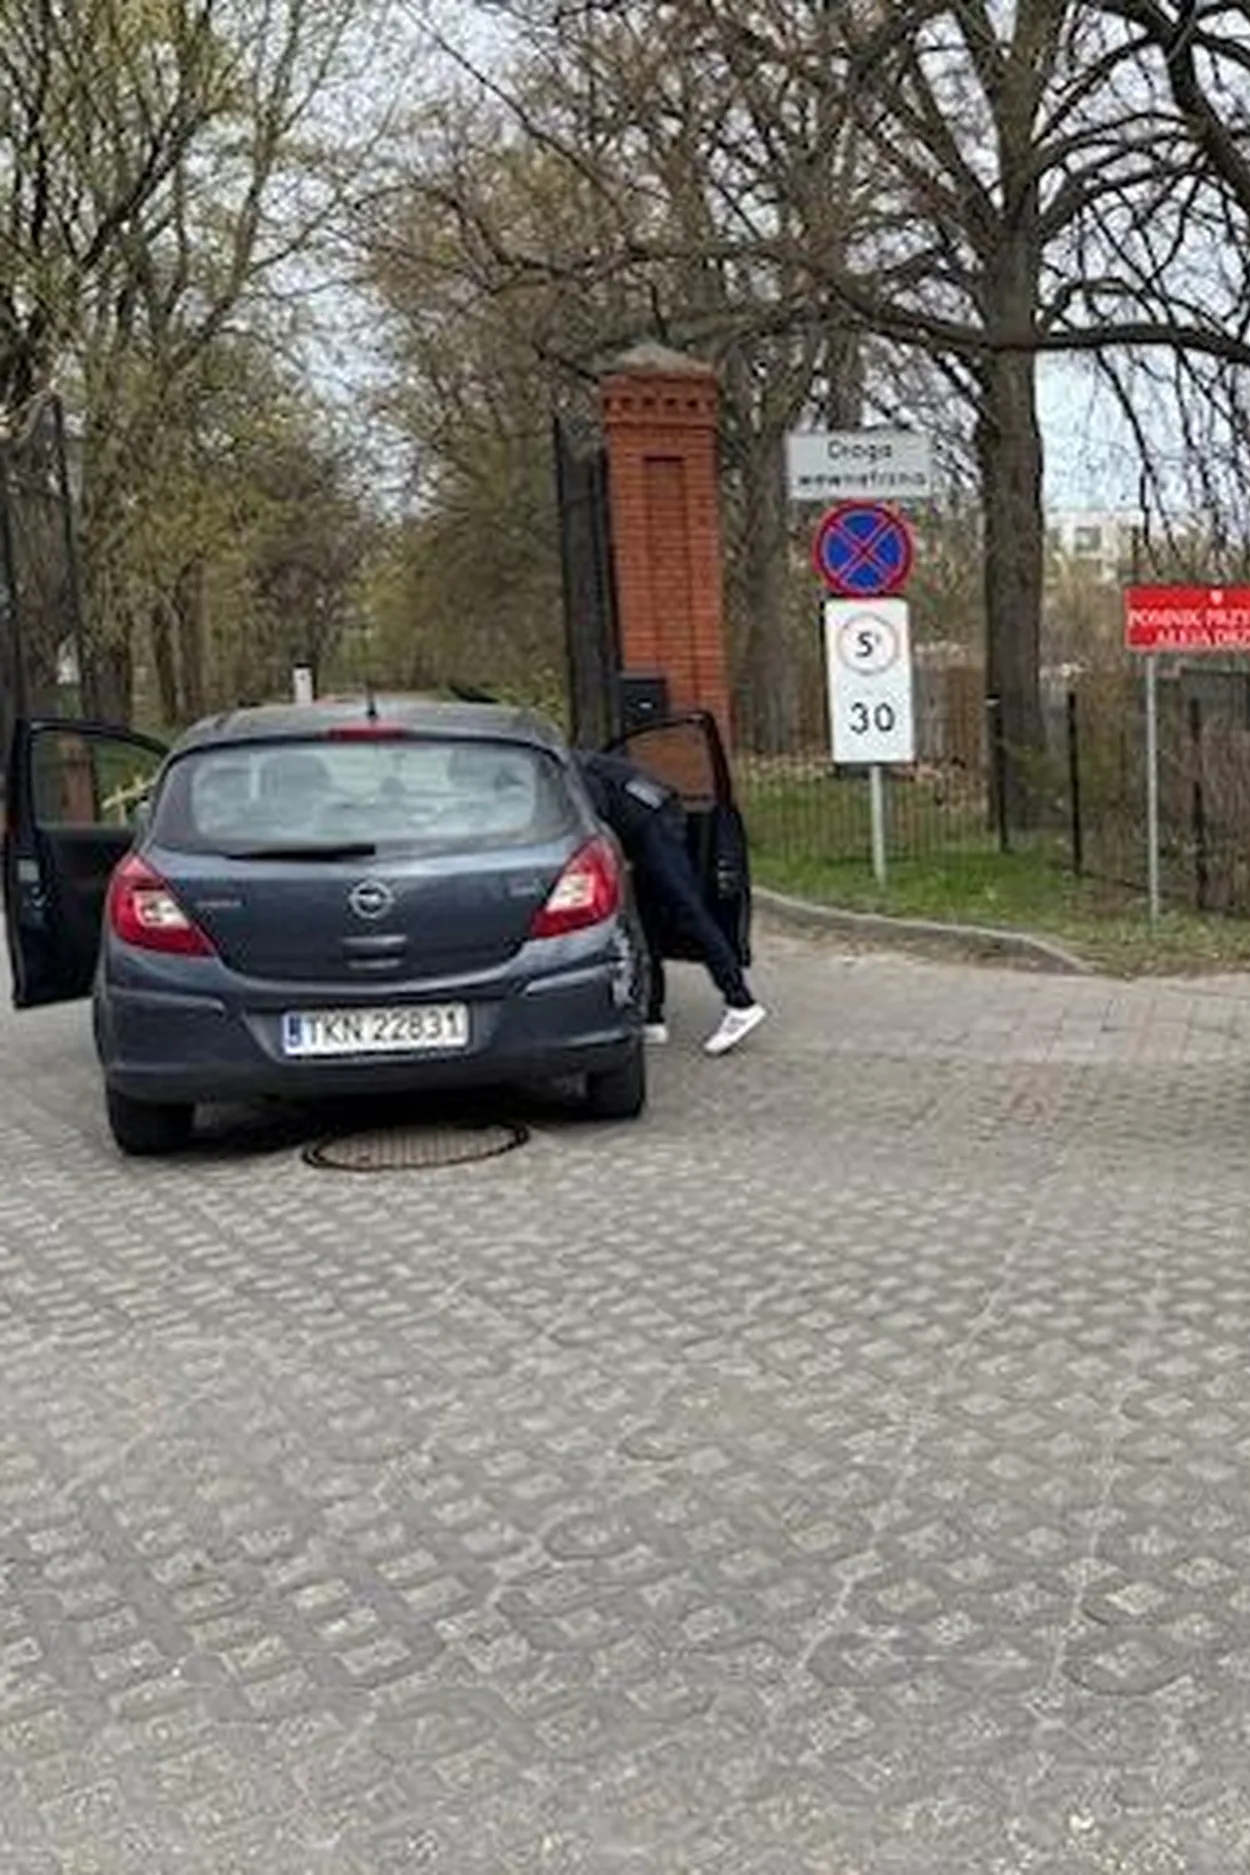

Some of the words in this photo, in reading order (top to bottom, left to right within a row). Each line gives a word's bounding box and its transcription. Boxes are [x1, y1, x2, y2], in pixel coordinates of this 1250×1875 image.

[828, 440, 892, 463] Droga
[850, 702, 895, 734] 30
[308, 1013, 362, 1042] TKN
[372, 1008, 461, 1039] 22831
